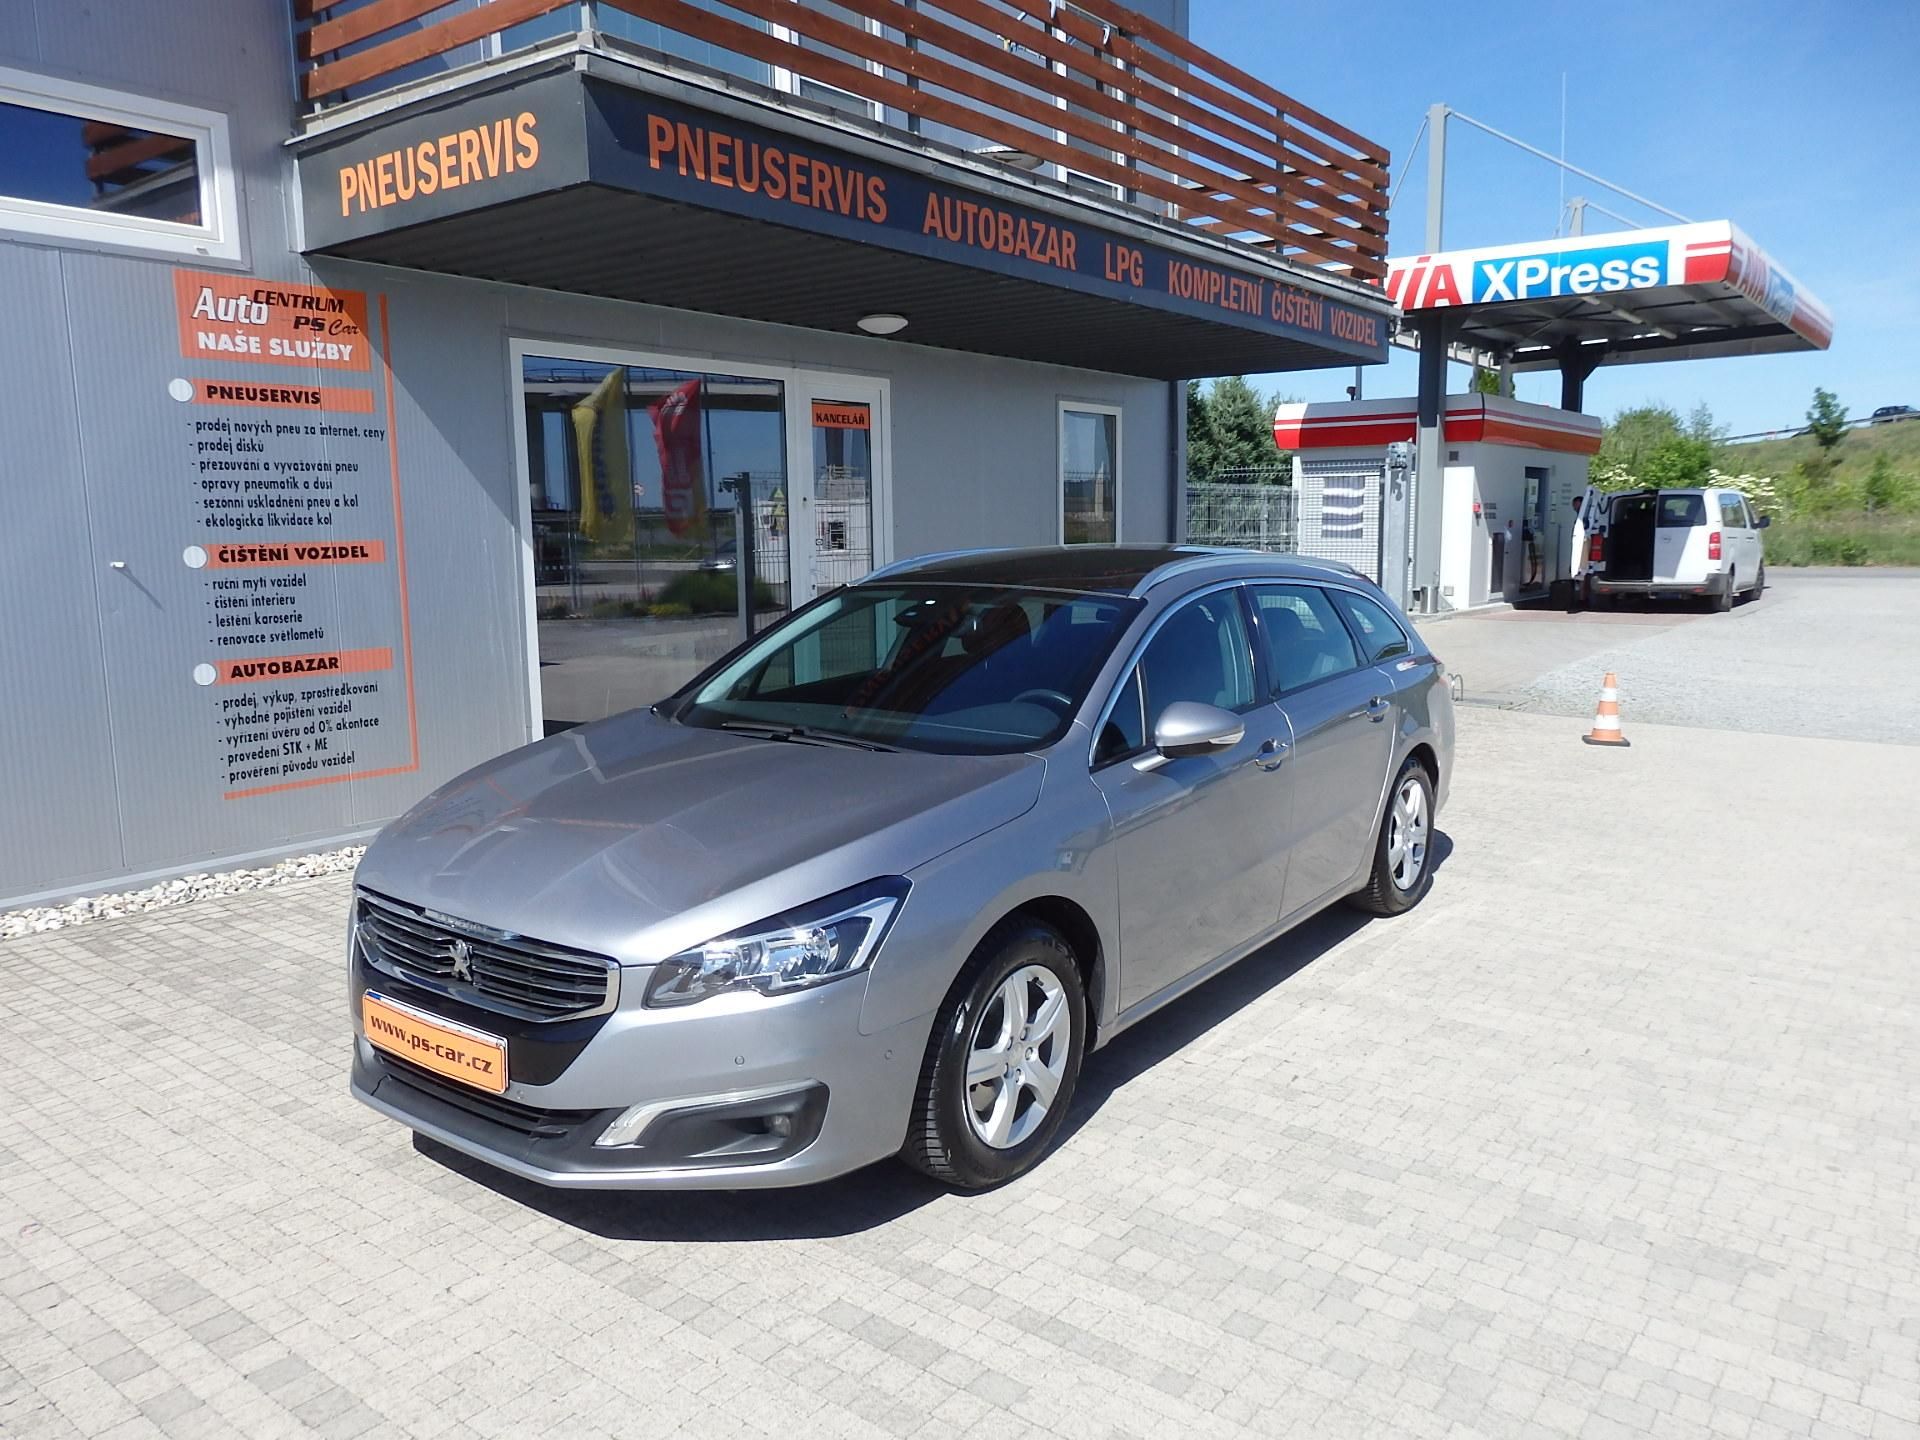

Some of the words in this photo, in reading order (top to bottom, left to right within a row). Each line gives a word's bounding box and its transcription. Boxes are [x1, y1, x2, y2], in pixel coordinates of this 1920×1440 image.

[339, 112, 540, 217] PNEUSERVIS
[647, 114, 888, 224] PNEUSERVIS
[922, 191, 1077, 271] AUTOBAZAR
[1104, 242, 1144, 287] LPG
[1168, 260, 1265, 316] KOMPLETNÍ
[1271, 281, 1325, 332] ČIŠTĚNÍ
[1329, 306, 1378, 347] VOZIDEL
[1481, 256, 1661, 303] XPress
[192, 286, 270, 325] Auto
[253, 289, 345, 313] CENTRUM
[293, 315, 326, 332] PS
[328, 319, 360, 336] Car
[197, 329, 262, 354] NAŠE
[269, 335, 353, 361] SLUŽBY
[206, 385, 321, 404] PNEUSERVIS
[816, 412, 865, 425] KANCELÁŘ
[195, 417, 231, 435] prodej
[234, 419, 273, 436] nových
[276, 424, 300, 437] pneu
[304, 425, 316, 435] za
[319, 422, 361, 437] internet.
[363, 428, 385, 441] ceny
[198, 437, 233, 455] prodej
[200, 458, 260, 474] přezouvání
[263, 462, 270, 471] a
[273, 460, 332, 475] vyvažování
[335, 462, 359, 475] pneu
[201, 480, 240, 493] opravy
[244, 476, 299, 493] pneumatik
[303, 481, 309, 489] a
[203, 495, 244, 509] sezónní
[307, 498, 331, 511] pneu
[334, 498, 340, 507] a
[343, 494, 359, 507] kol
[205, 512, 264, 530] ekologická
[267, 512, 314, 526] likvidace
[317, 512, 332, 525] kol
[218, 543, 289, 562] ČIŠTĚNÍ
[294, 545, 369, 560] VOZIDEL
[212, 577, 239, 590] ruční
[270, 573, 307, 587] vozidel
[251, 592, 296, 607] interiéru
[254, 610, 303, 625] karoserie
[217, 633, 266, 646] renovace
[270, 627, 324, 643] světlometů
[231, 656, 339, 679] AUTOBAZAR
[224, 709, 270, 730] výhodné
[318, 700, 352, 716] vozidel
[304, 721, 315, 735] od
[318, 719, 333, 733] 0%
[336, 717, 380, 731] akontace
[227, 745, 280, 767] provedení
[282, 741, 303, 756] STK
[314, 737, 328, 751] ME
[229, 762, 279, 785] prověření
[282, 756, 318, 776] původu
[321, 750, 355, 768] vozidel
[370, 1015, 493, 1075] www.ps-car.cz
